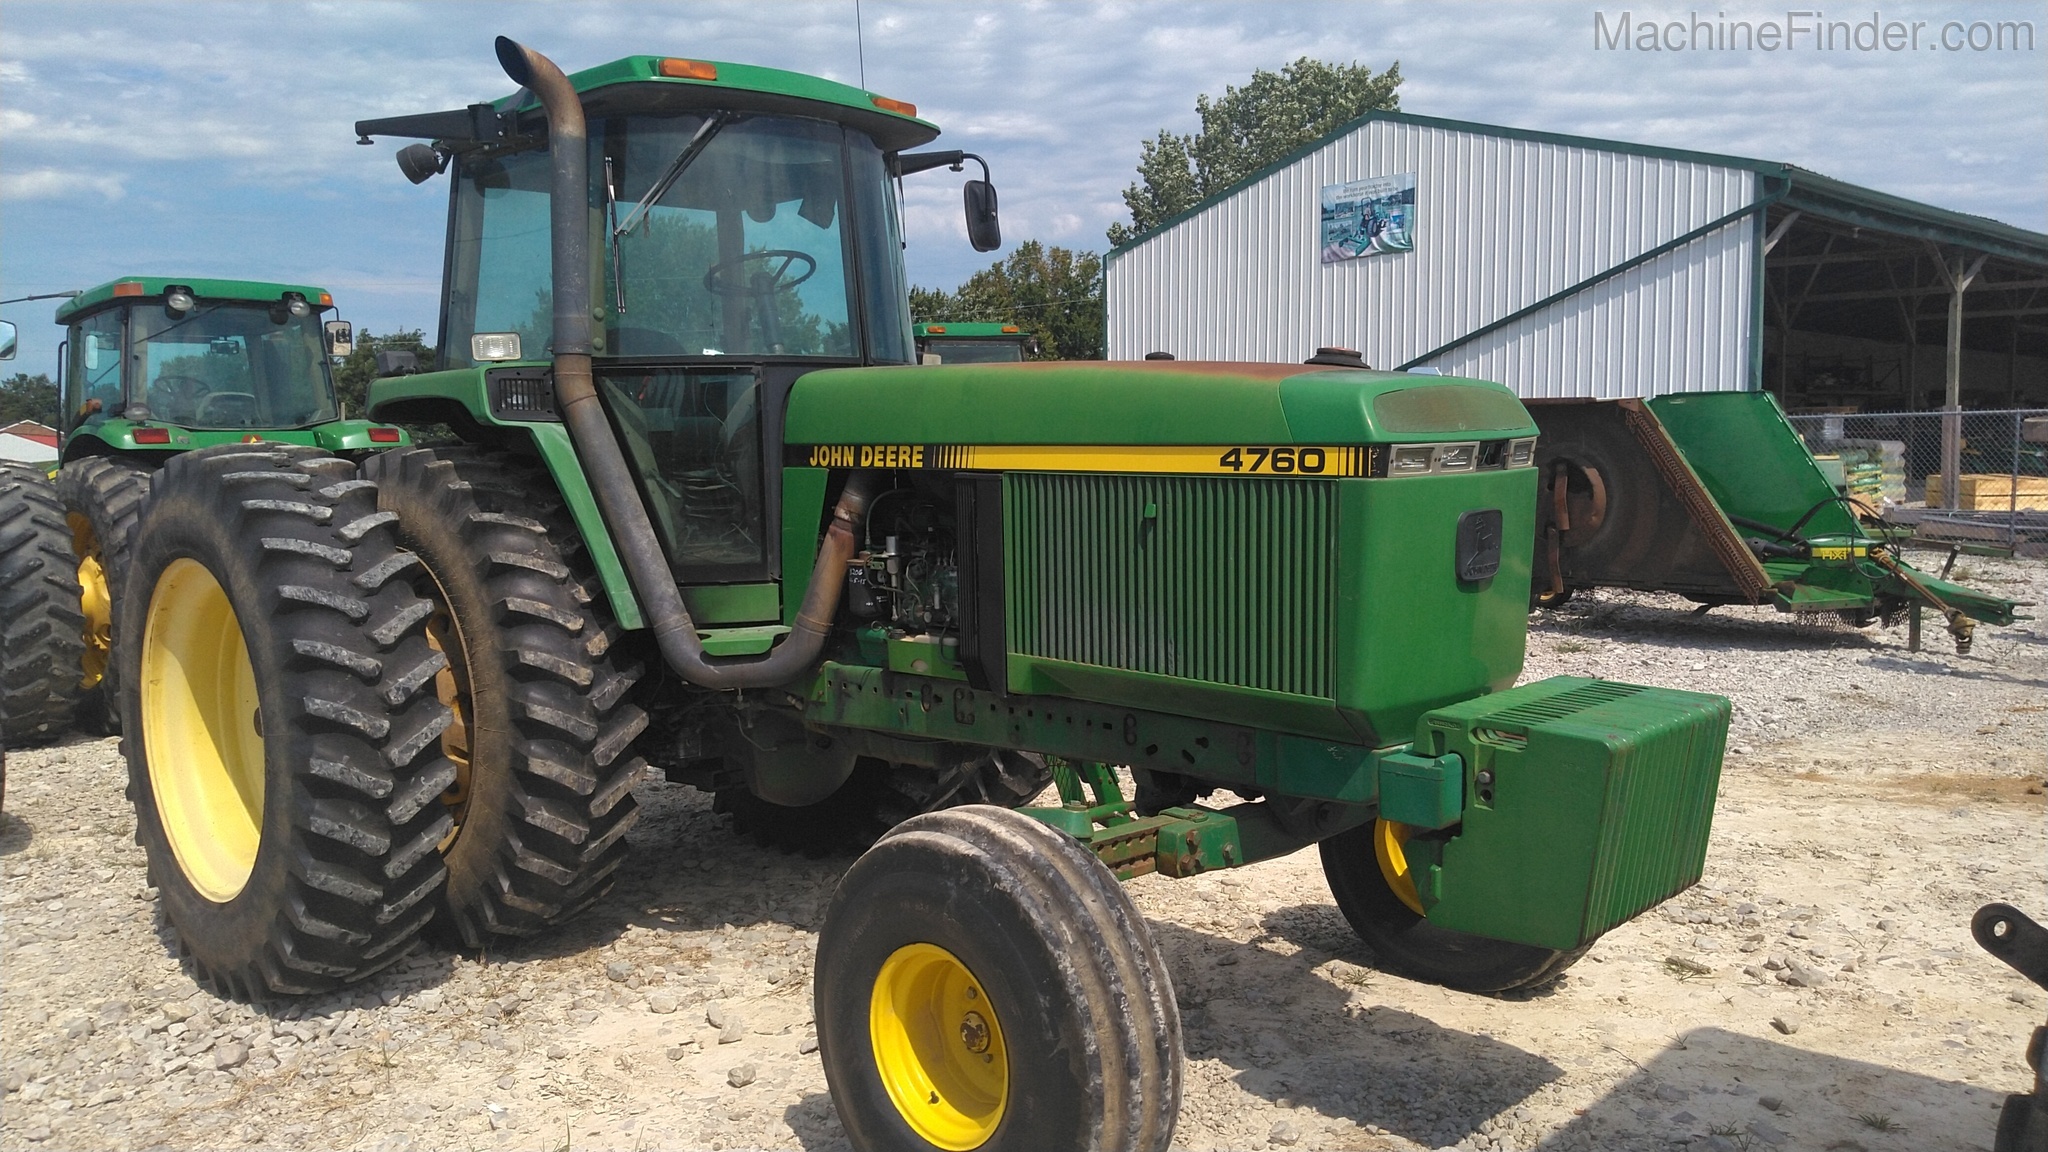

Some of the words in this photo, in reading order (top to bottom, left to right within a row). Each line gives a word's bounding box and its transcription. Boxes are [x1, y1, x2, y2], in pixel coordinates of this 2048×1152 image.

[809, 445, 855, 467] JOHN
[860, 445, 924, 468] DEERE
[1220, 448, 1325, 473] 4760
